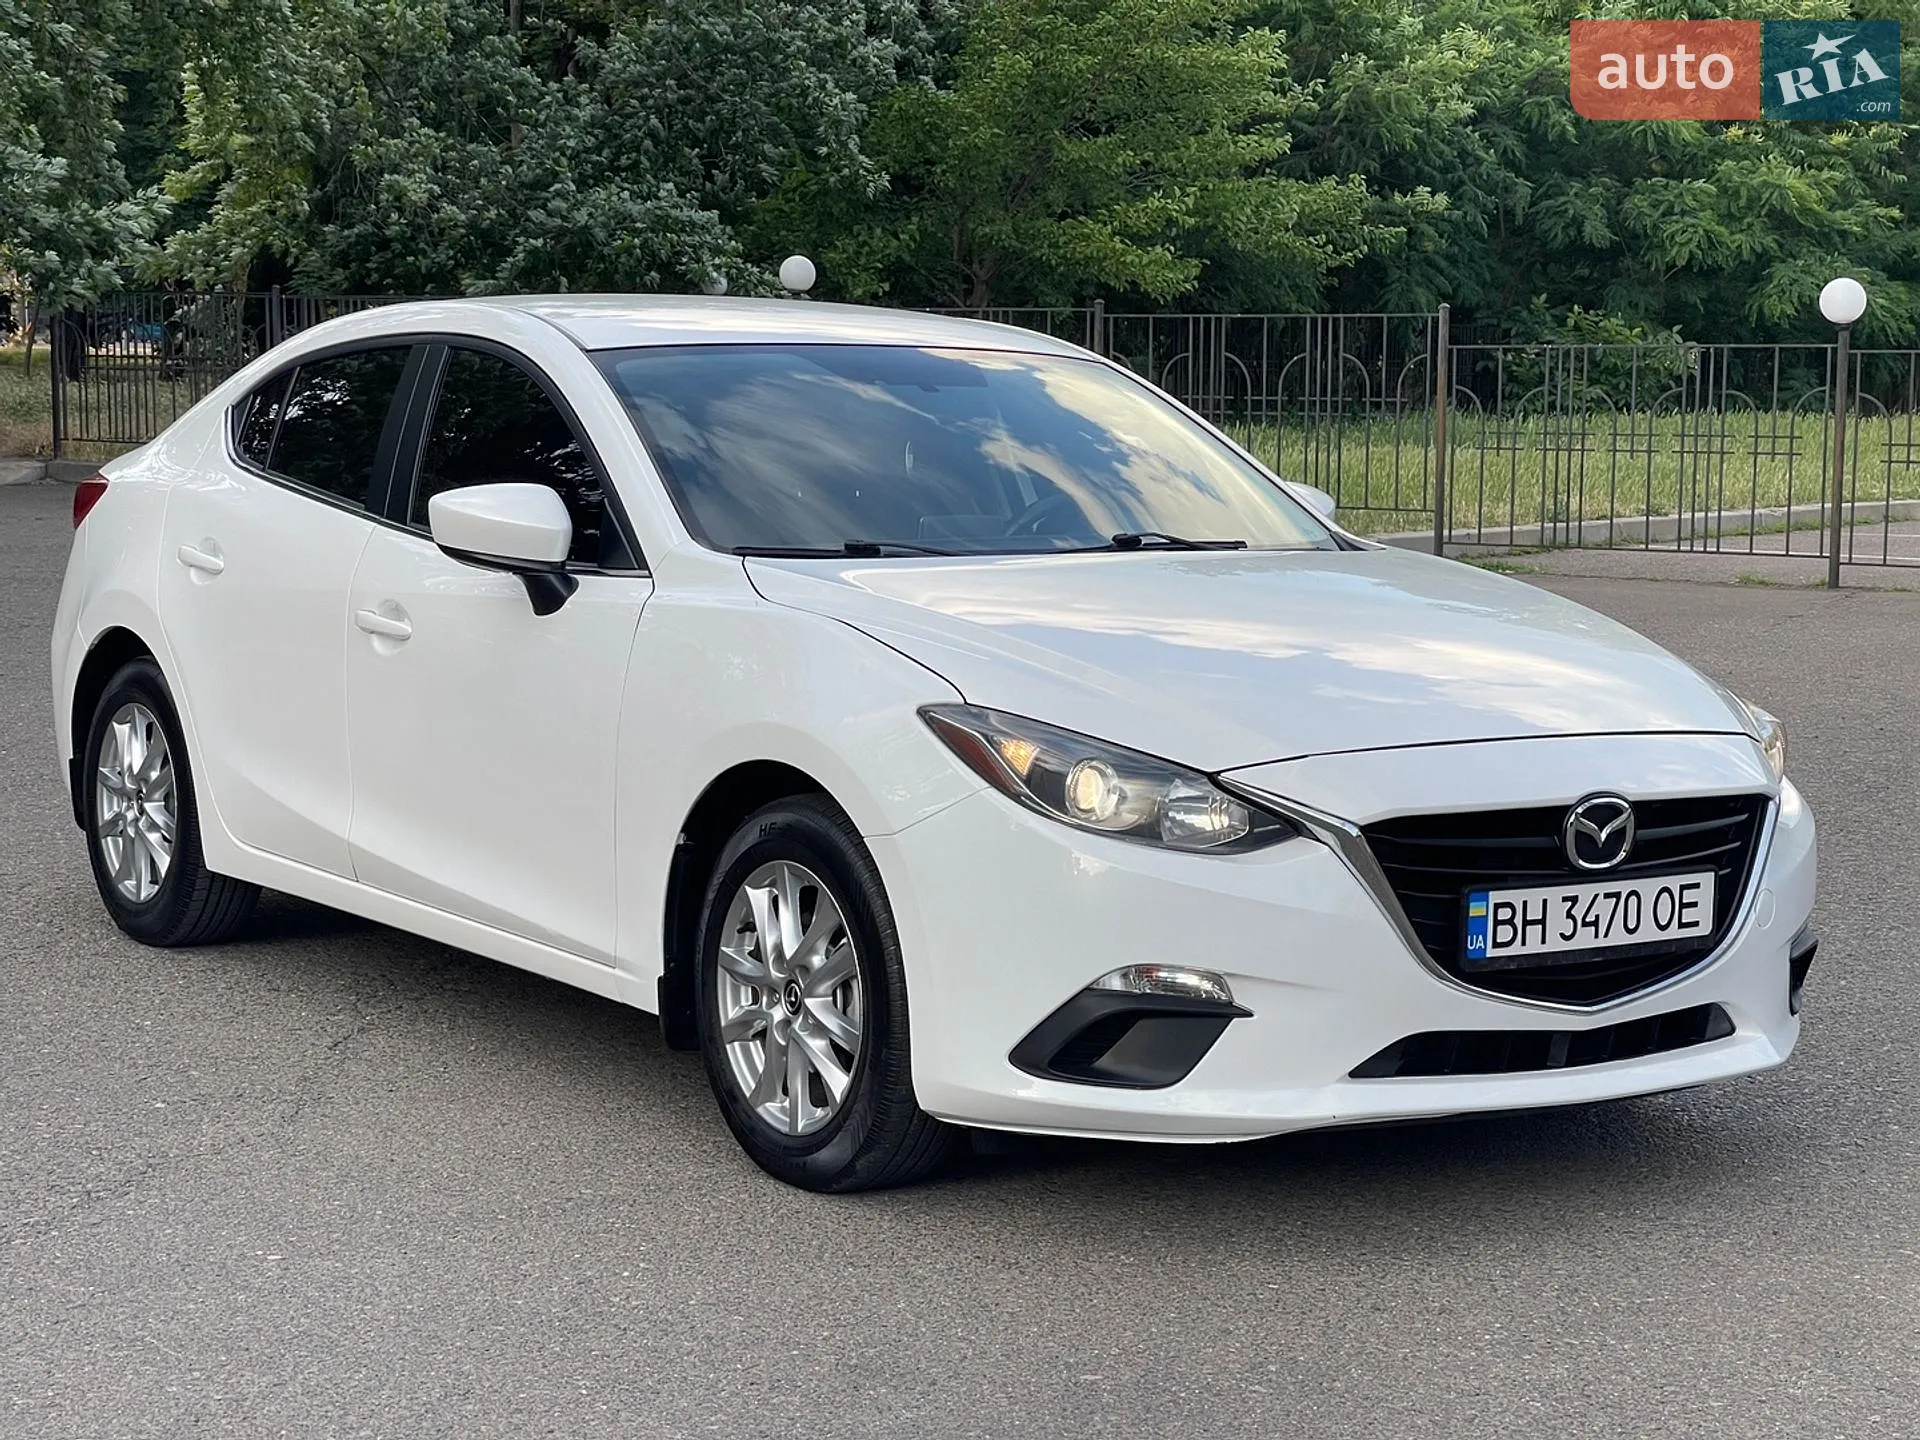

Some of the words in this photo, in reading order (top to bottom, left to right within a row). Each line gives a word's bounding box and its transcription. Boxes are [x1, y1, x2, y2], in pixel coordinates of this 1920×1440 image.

[1491, 898, 1548, 949] BH
[1558, 889, 1643, 942] 3470
[1652, 882, 1701, 932] OE
[1467, 934, 1486, 951] UA
